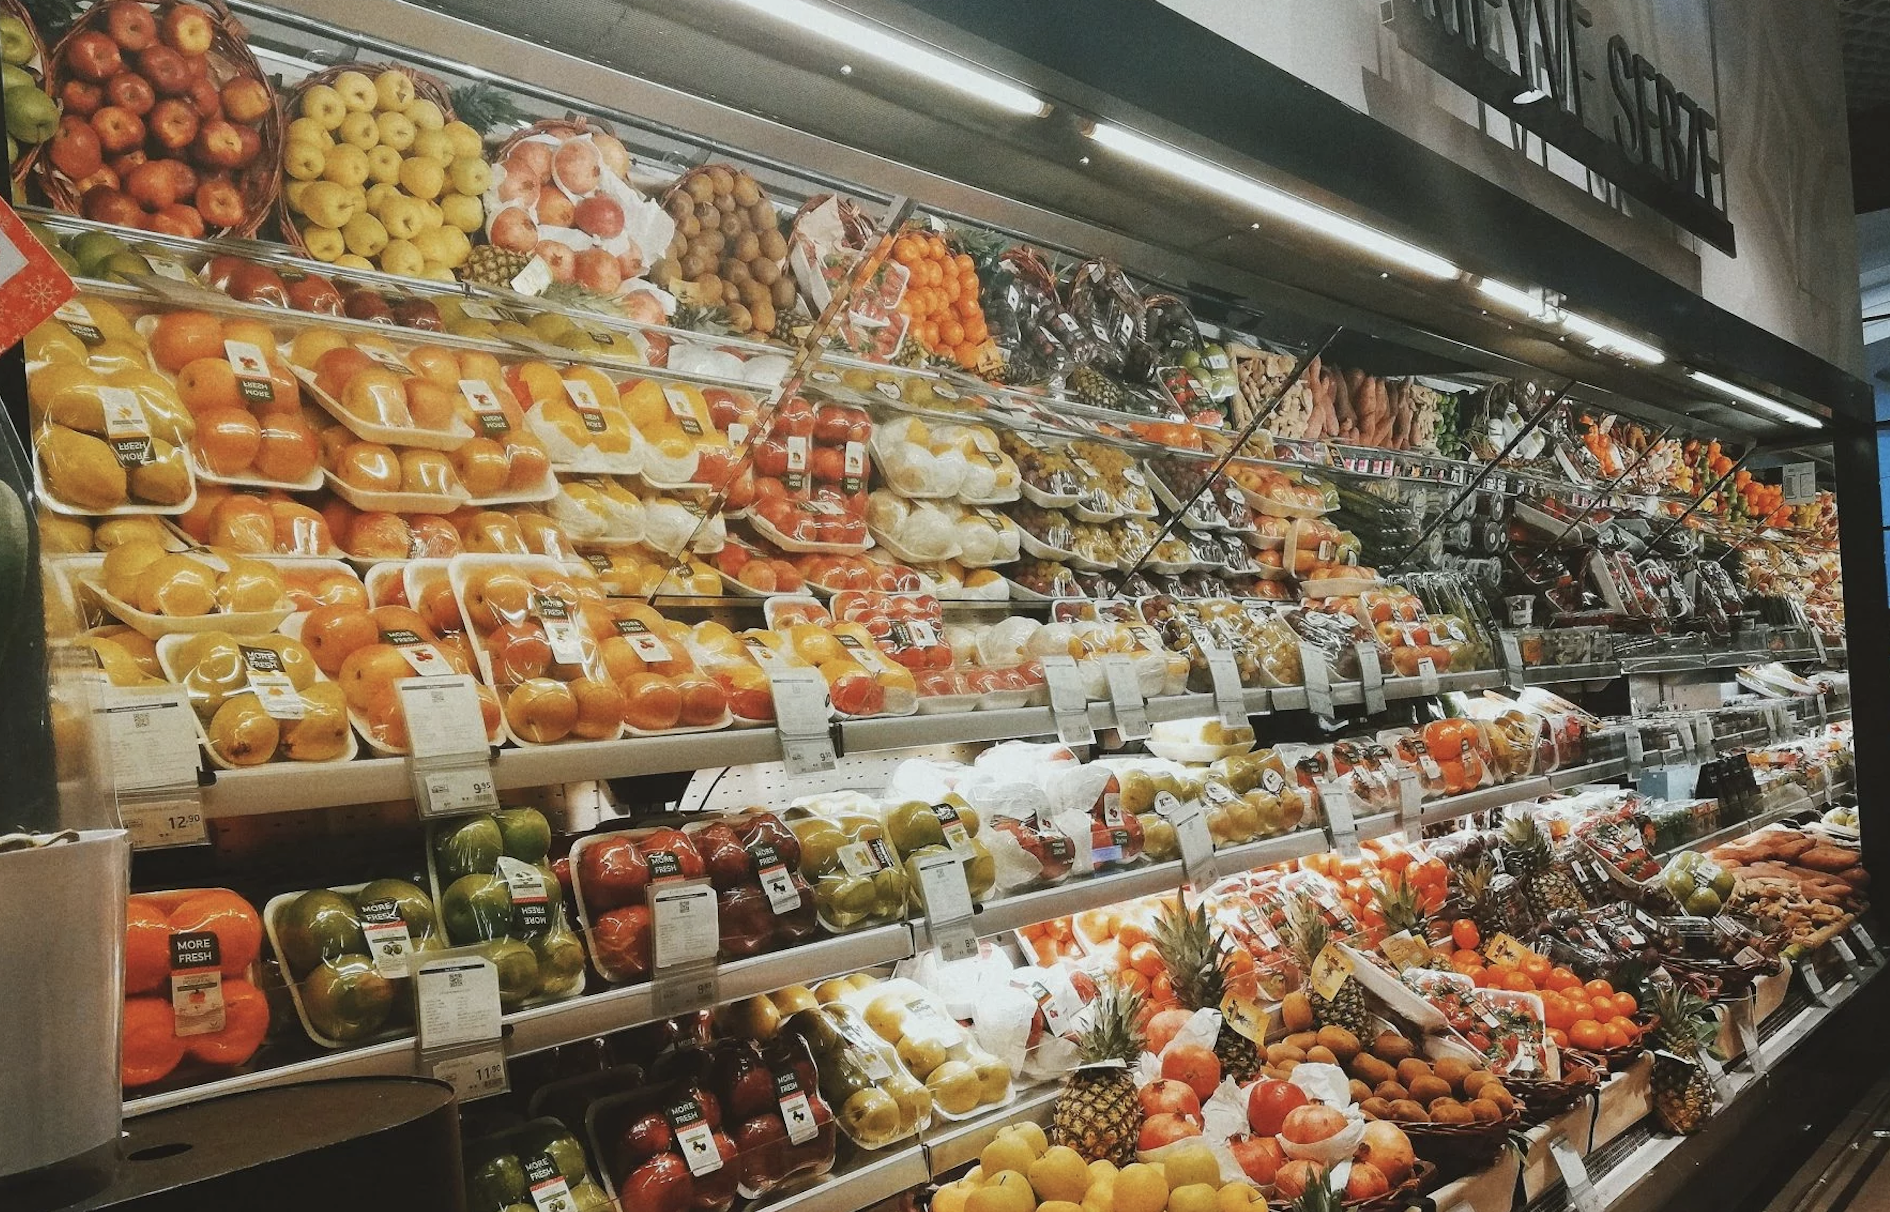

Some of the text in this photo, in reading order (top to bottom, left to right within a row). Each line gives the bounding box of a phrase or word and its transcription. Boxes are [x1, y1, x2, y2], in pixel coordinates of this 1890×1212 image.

[617, 620, 641, 628] MORE
[387, 630, 415, 638] MORE
[393, 635, 420, 643] FRESH
[246, 650, 277, 662] MORE
[754, 846, 775, 858] MORE
[651, 855, 675, 866] MORE
[759, 855, 779, 867] FRESH
[654, 864, 678, 875] FRESH
[361, 901, 393, 914] MORE
[521, 905, 546, 915] FRESH
[524, 916, 547, 925] MORE
[177, 938, 211, 951] MORE
[178, 951, 213, 964] FRESH
[777, 1072, 795, 1084] MORE
[780, 1082, 799, 1094] FRESH
[671, 1101, 696, 1116] MORE
[675, 1111, 699, 1125] FRESH
[524, 1157, 550, 1173] MORE
[529, 1167, 555, 1182] FRESH
